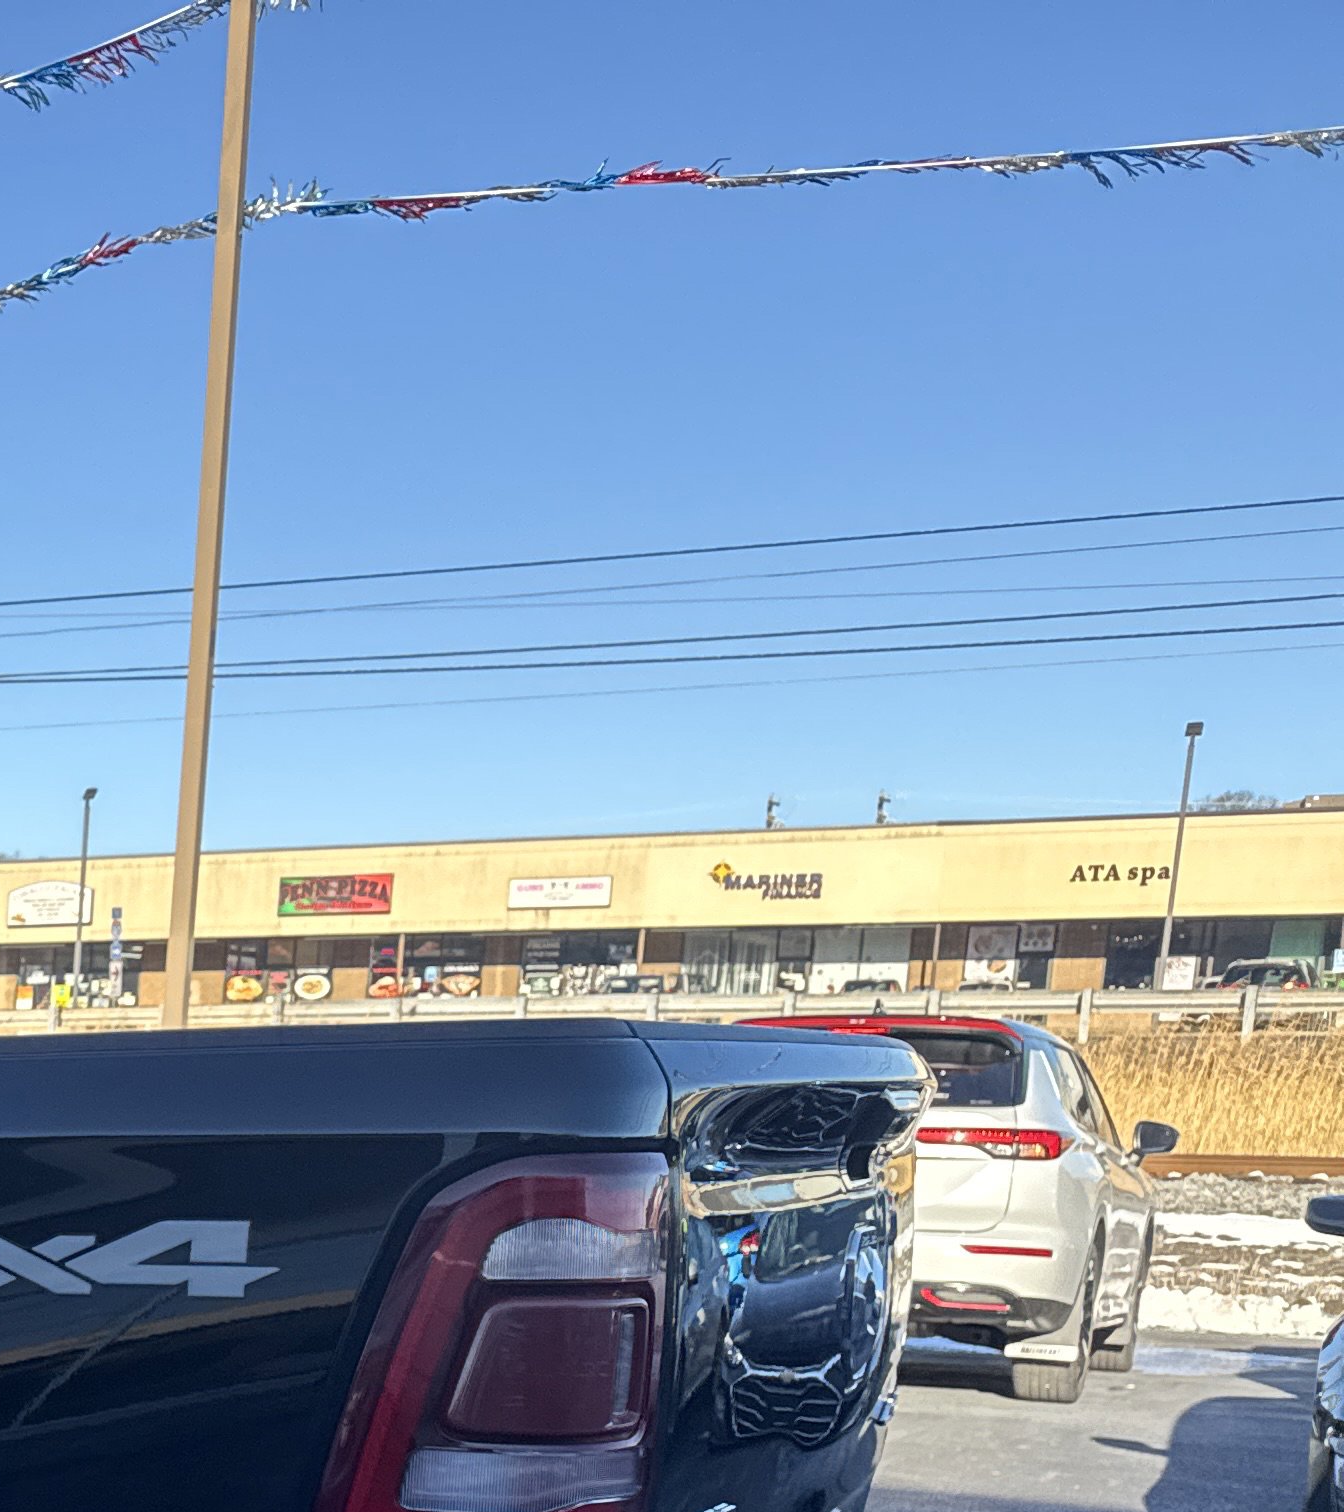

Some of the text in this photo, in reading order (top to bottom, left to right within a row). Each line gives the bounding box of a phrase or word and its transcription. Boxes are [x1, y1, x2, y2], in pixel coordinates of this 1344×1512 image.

[723, 873, 823, 891] MARINER
[1069, 863, 1171, 887] ATA spa
